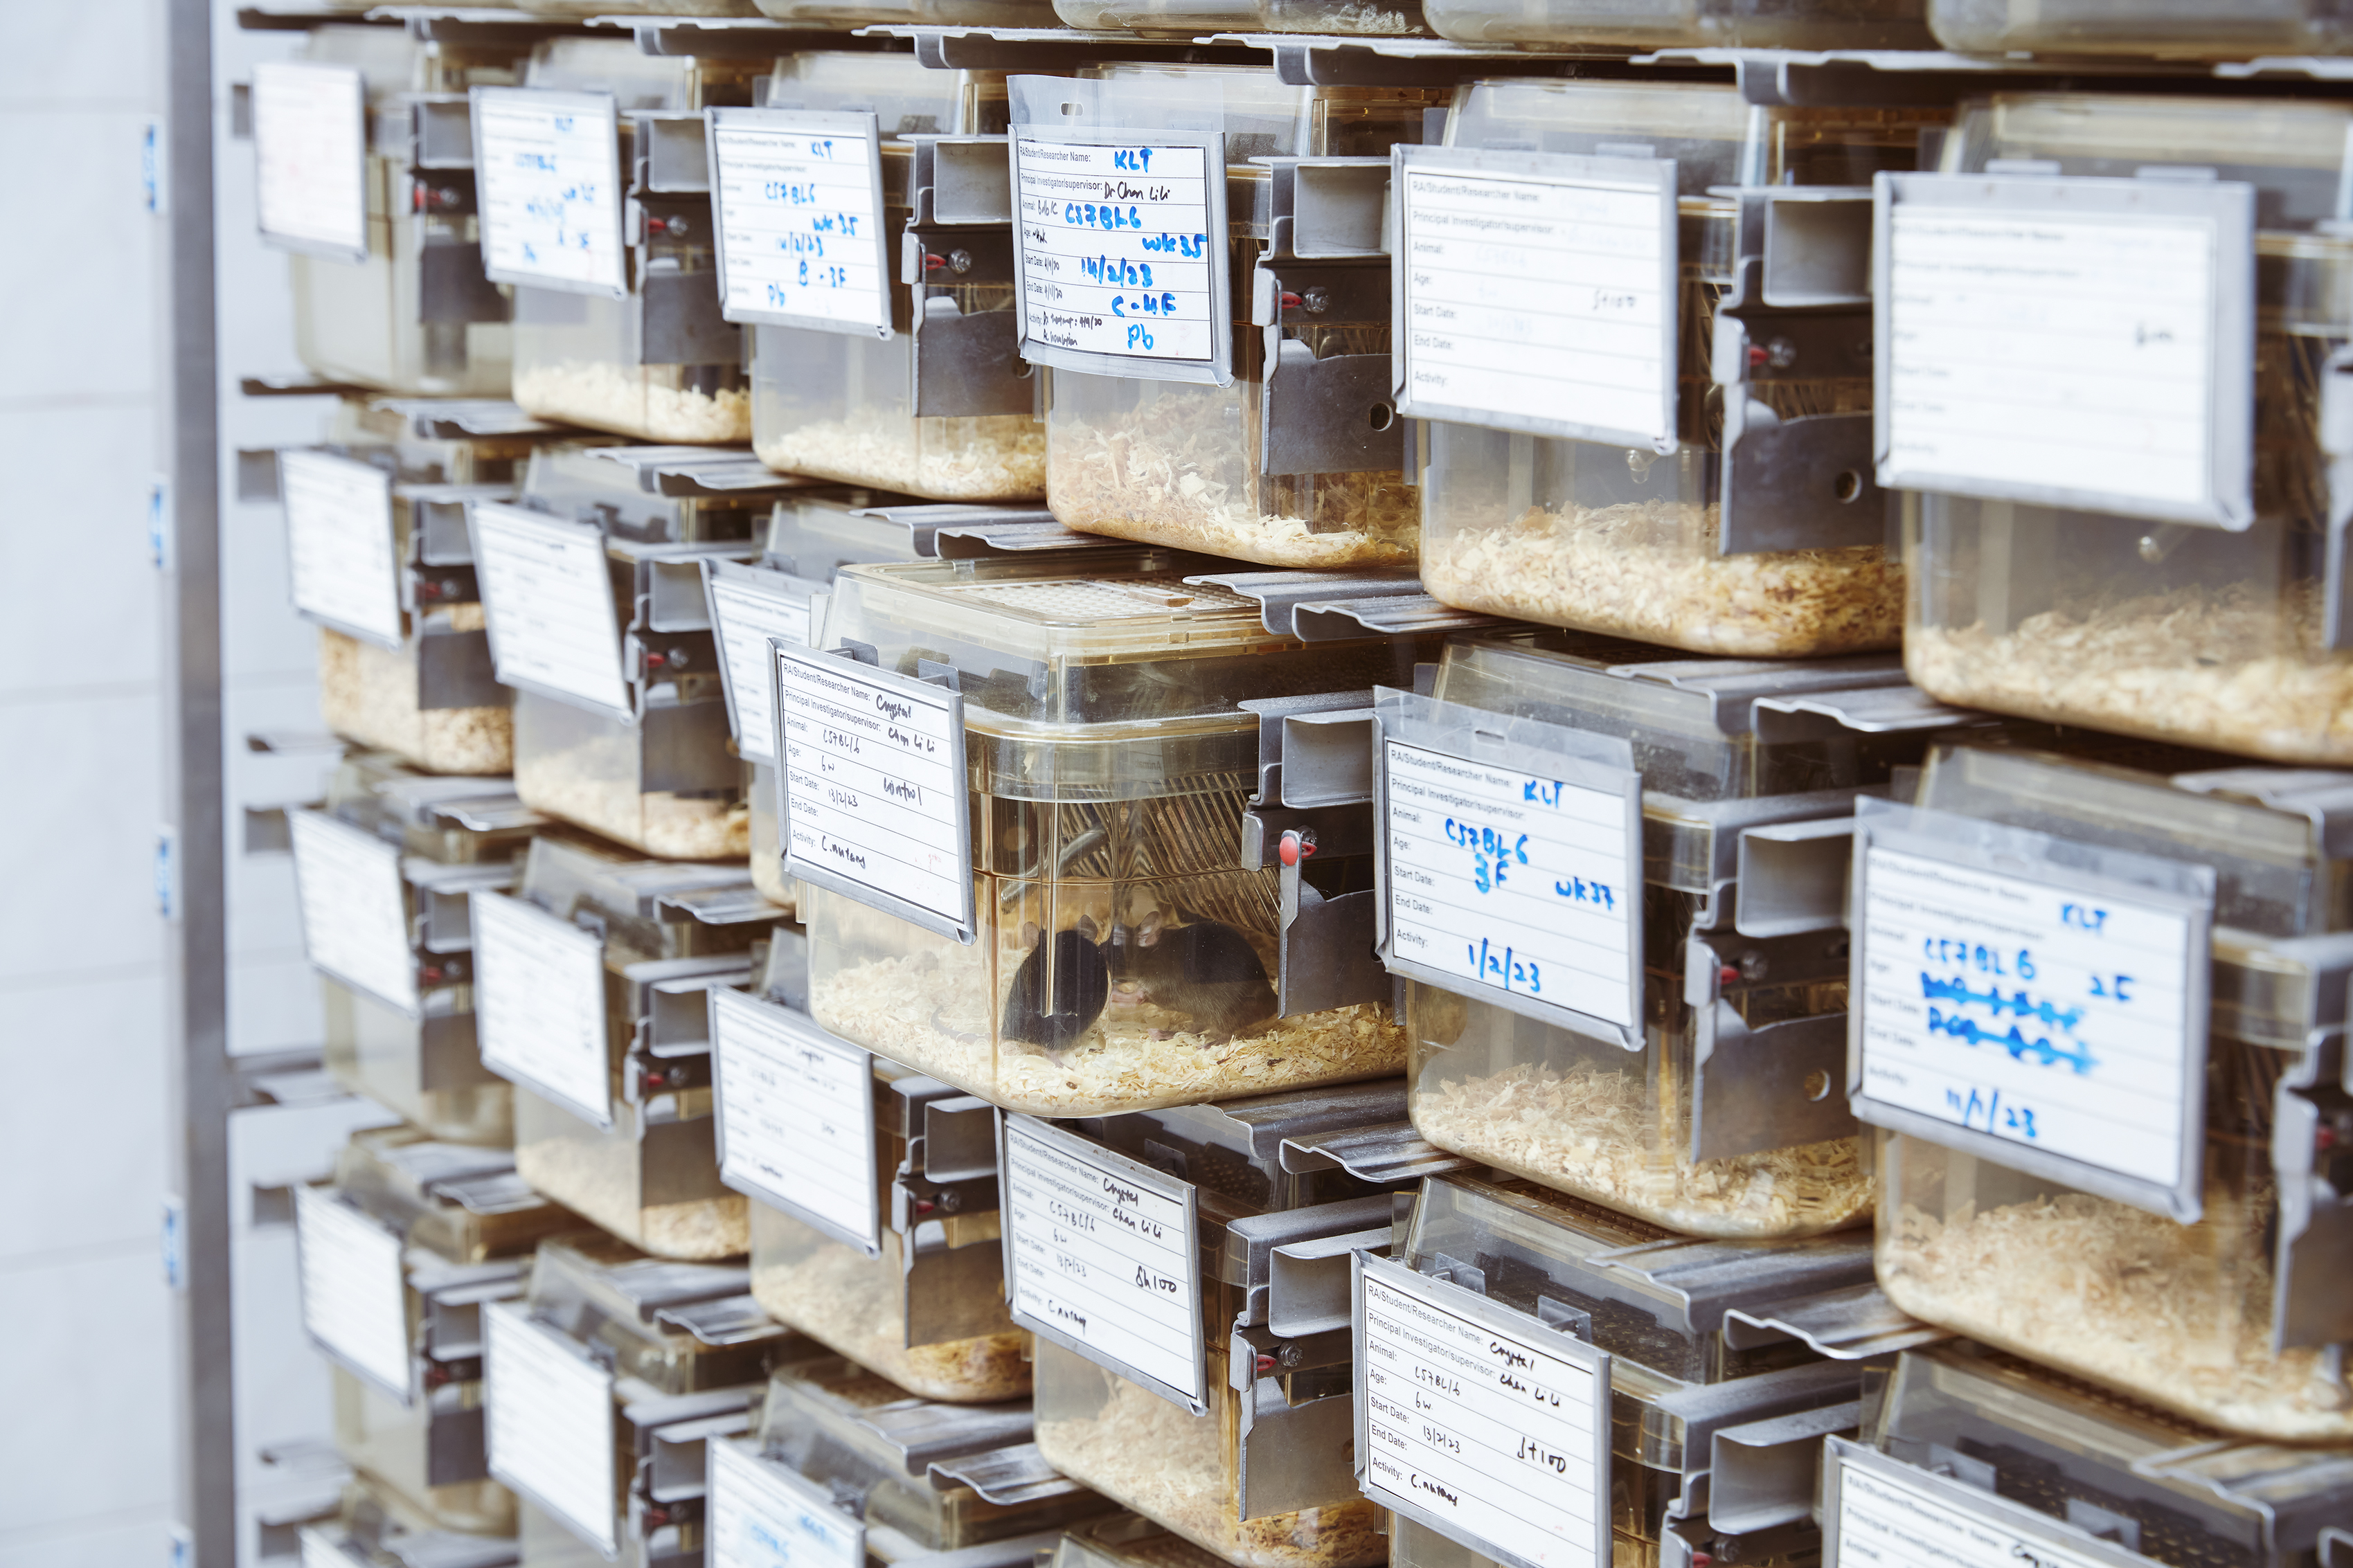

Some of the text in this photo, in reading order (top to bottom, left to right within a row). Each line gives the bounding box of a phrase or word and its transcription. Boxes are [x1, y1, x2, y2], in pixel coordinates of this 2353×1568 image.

[1070, 152, 1091, 162] Name:
[1114, 148, 1153, 173] KLT
[1021, 172, 1036, 186] Principal
[1104, 181, 1115, 199] Dr
[1025, 254, 1044, 267] Start Date:
[1034, 282, 1044, 294] Date:
[1127, 323, 1154, 350] Pb
[783, 663, 870, 701] RA/Student/Researcher Name:
[785, 690, 881, 732] Principal Investigator/supervisor:
[787, 717, 808, 732] Animal:
[788, 744, 801, 757] Age:
[789, 771, 819, 791] Start Date:
[1392, 778, 1425, 797] Principal
[1524, 780, 1564, 809] KLT
[791, 797, 818, 818] End Date:
[1393, 806, 1421, 823] Animal:
[793, 829, 816, 848] Activity:
[1394, 836, 1411, 850] Age:
[1394, 866, 1435, 887] Start Date:
[1395, 894, 1433, 915] End Date:
[1397, 928, 1429, 948] Activity:
[1468, 937, 1540, 993] 1/2/23
[1011, 1157, 1036, 1178] Principal
[1079, 1166, 1099, 1184] Name:
[1015, 1232, 1046, 1255] Start Date:
[1017, 1256, 1045, 1279] End Date:
[1368, 1284, 1483, 1345] RA/Student/Researcher Name:
[1368, 1313, 1496, 1380] Principal Investigator/supervisor:
[1369, 1340, 1397, 1362] Animal:
[1370, 1369, 1387, 1385] Age:
[1370, 1396, 1410, 1425] Start Date:
[1372, 1424, 1408, 1451] End Date:
[1423, 1425, 1460, 1454] 13/2/23
[1372, 1457, 1403, 1481] Activity:
